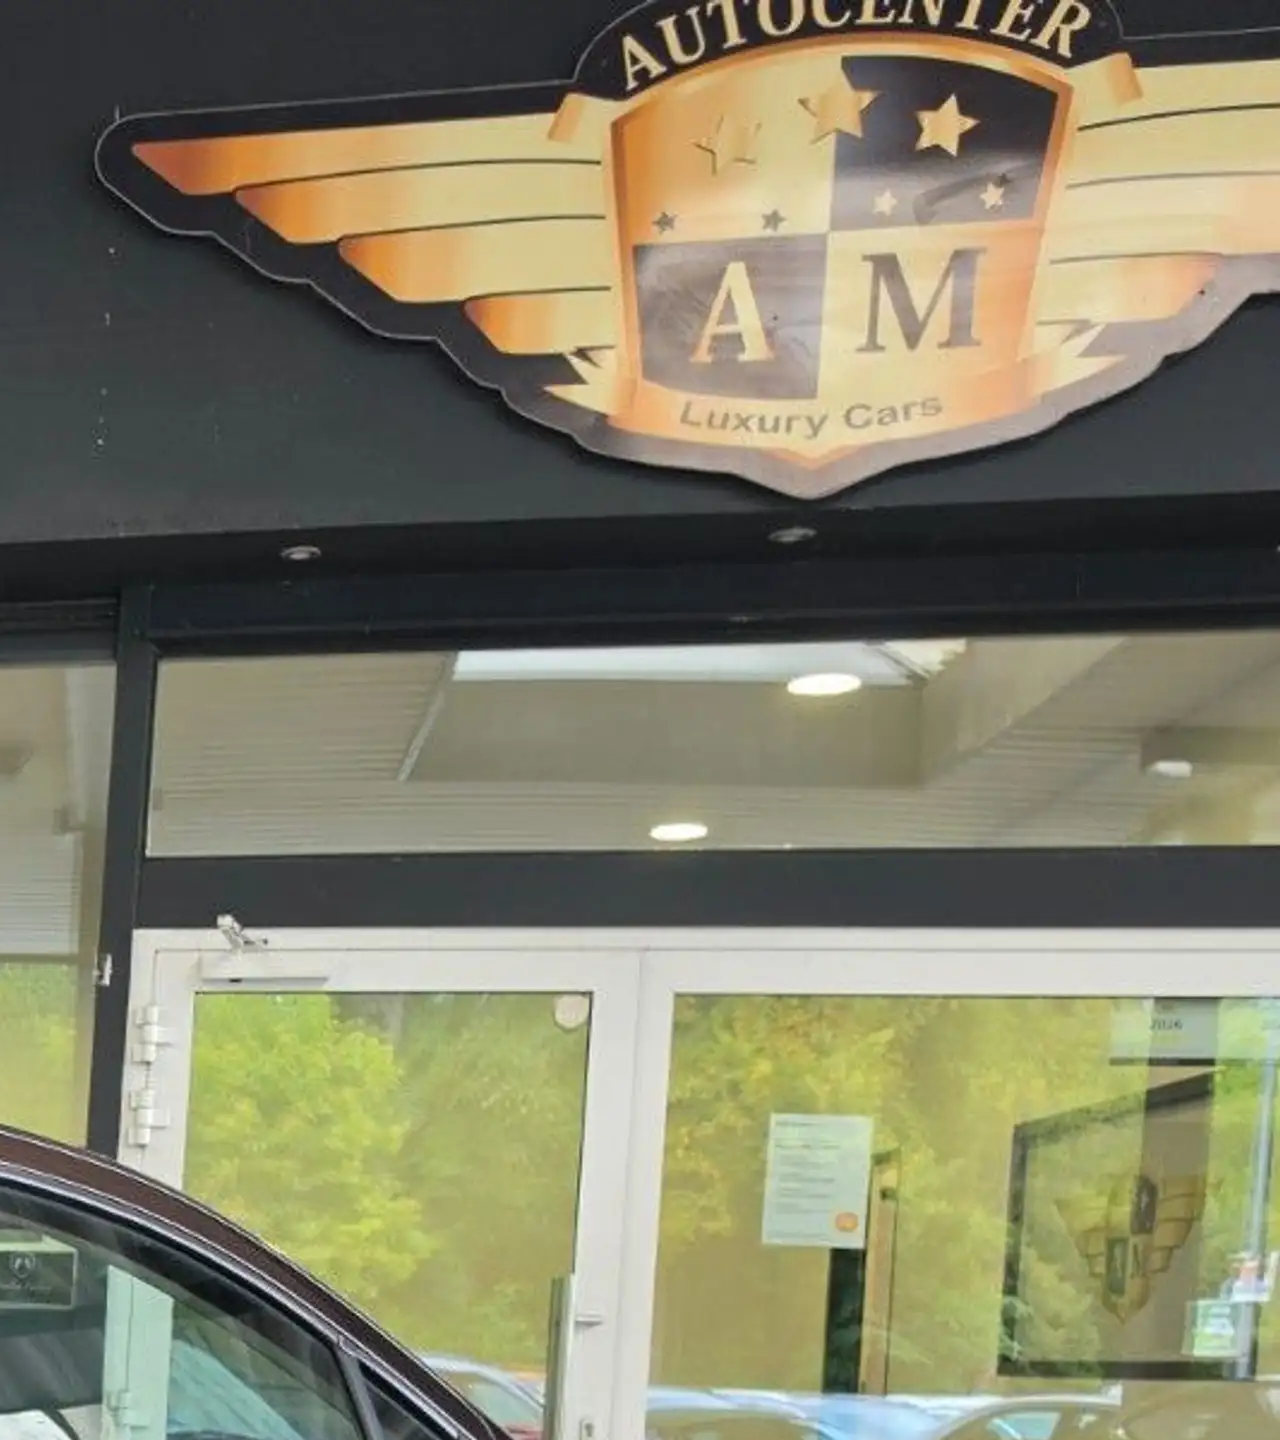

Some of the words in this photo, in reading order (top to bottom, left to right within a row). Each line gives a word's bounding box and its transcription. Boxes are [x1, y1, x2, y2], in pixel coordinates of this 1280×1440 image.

[622, 0, 1091, 91] AUTOCENTER
[689, 260, 775, 363] A
[855, 248, 987, 352] M
[679, 401, 829, 439] Luxury
[843, 397, 944, 430] Cars
